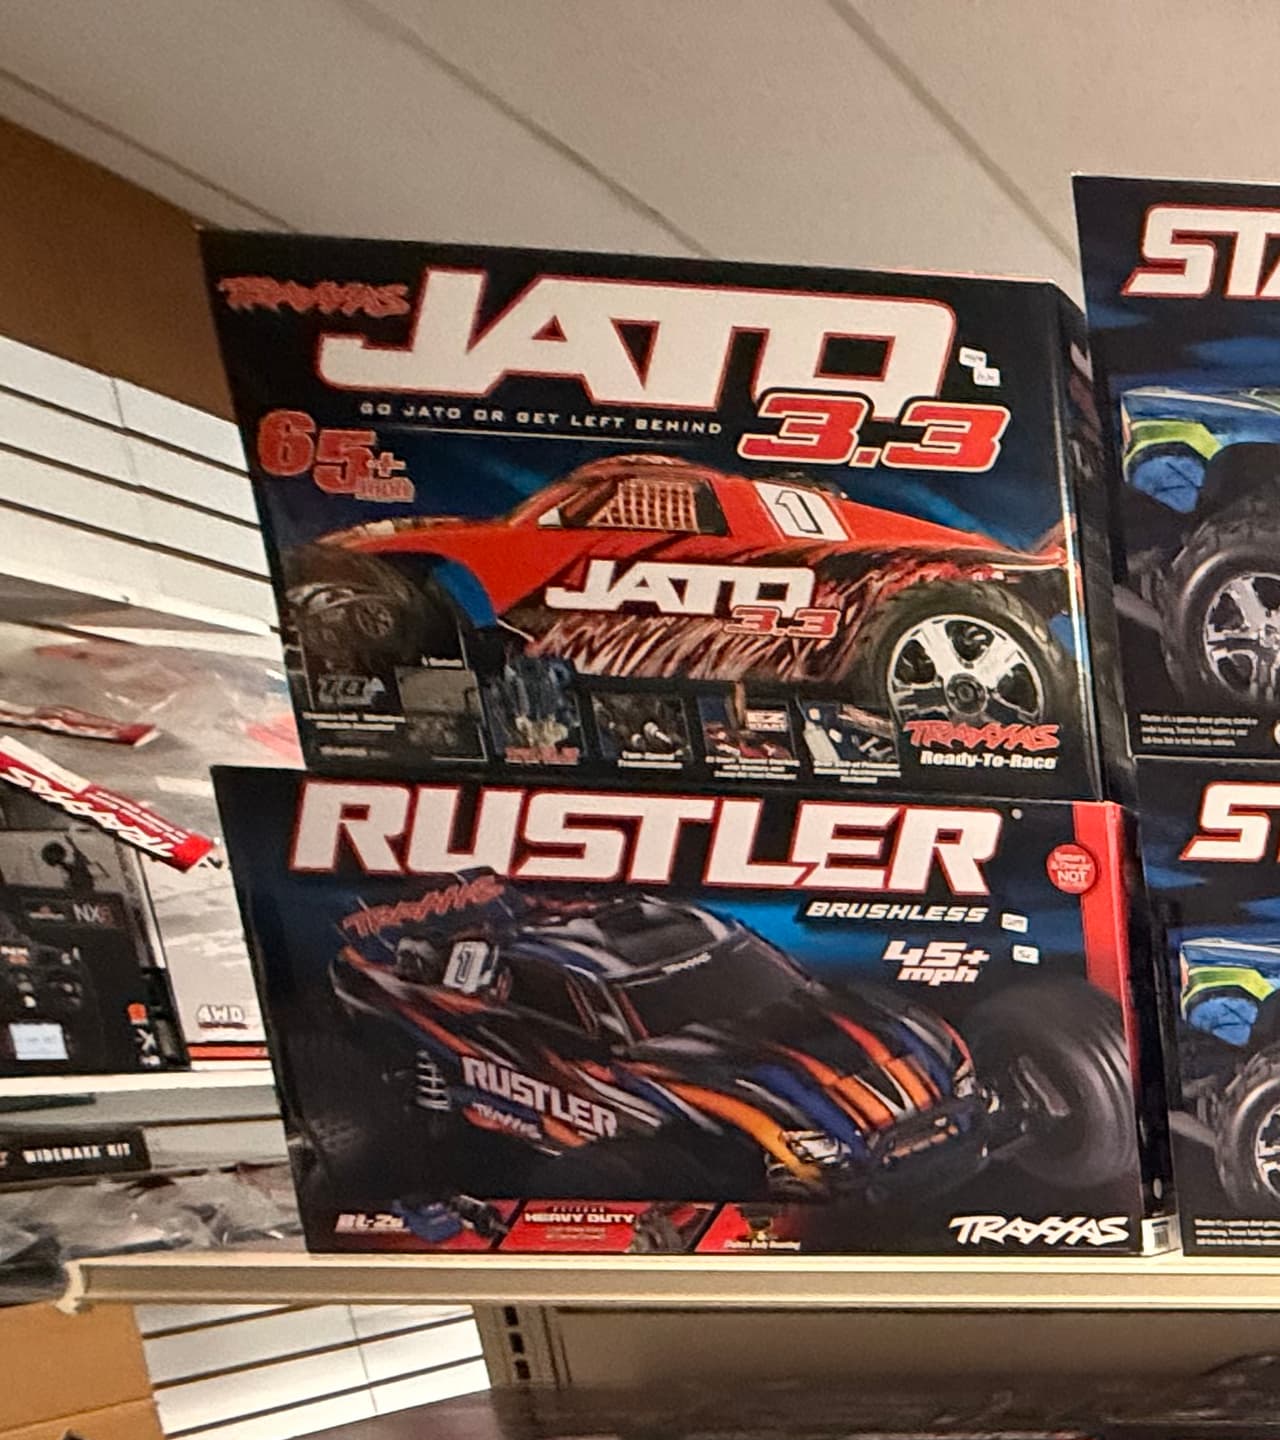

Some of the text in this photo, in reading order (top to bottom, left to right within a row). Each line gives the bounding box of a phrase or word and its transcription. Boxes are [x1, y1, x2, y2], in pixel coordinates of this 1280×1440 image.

[218, 275, 410, 317] TRAXXAS
[316, 266, 957, 421] JATO
[360, 402, 722, 435] GO JATO OR GET LEFT BEHIND
[738, 393, 1010, 471] 3.3
[545, 561, 818, 617] JATO
[724, 605, 840, 639] 3.3
[904, 719, 1062, 751] TRAXXAS
[920, 750, 1058, 770] Ready-To-Race
[0, 766, 176, 858] TRAXXAS
[289, 777, 1002, 895] RUSTLER
[1057, 869, 1087, 883] NOT
[806, 902, 988, 924] BRUSHLESS
[883, 941, 990, 965] 45+
[897, 965, 979, 986] mph
[197, 1004, 245, 1024] 4WD
[462, 1056, 619, 1139] RUSTLER
[107, 1142, 131, 1157] KIT
[524, 1212, 636, 1224] HEAVY DUTY
[950, 1216, 1130, 1246] TRAXXAS
